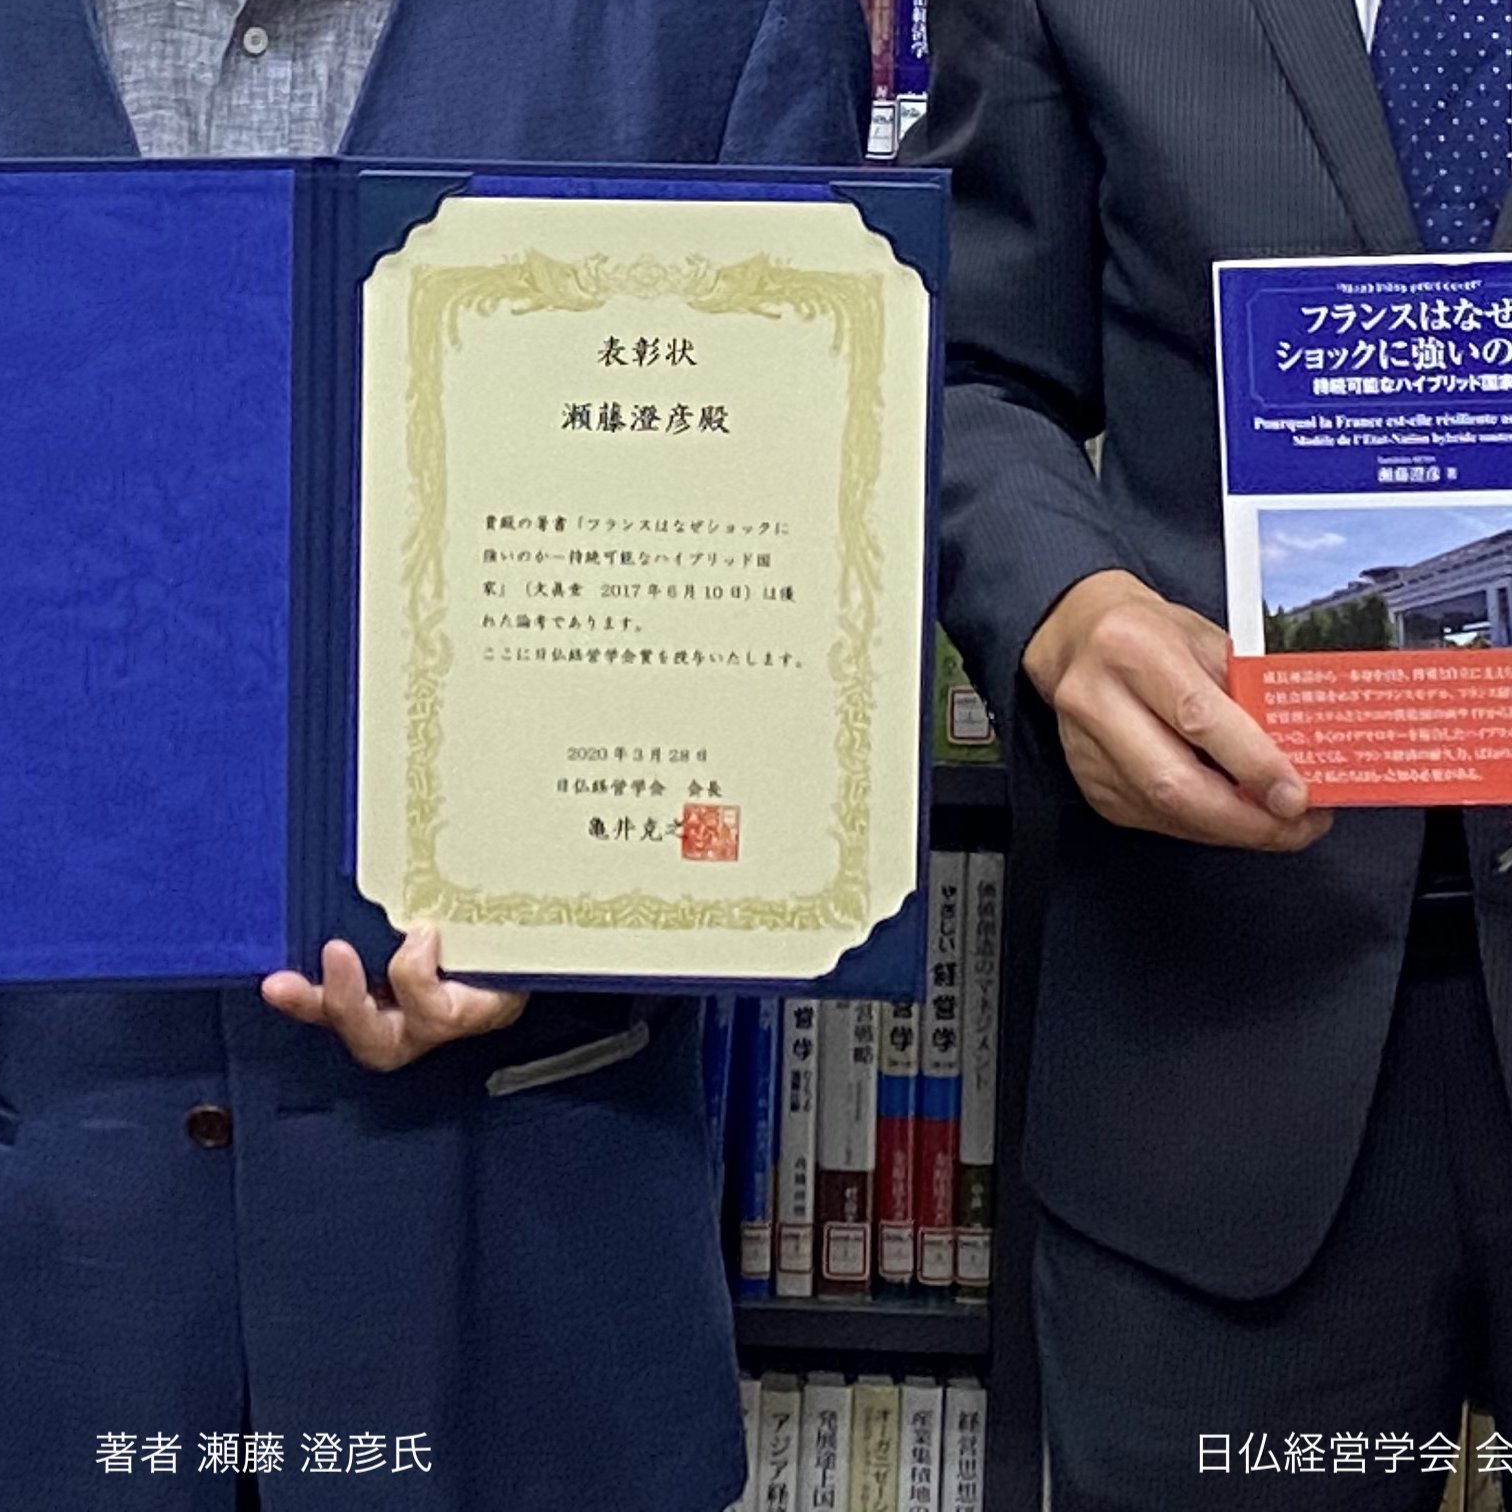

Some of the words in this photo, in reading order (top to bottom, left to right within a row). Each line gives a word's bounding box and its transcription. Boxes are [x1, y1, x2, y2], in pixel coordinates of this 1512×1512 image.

[597, 336, 698, 368] 表彰状
[560, 403, 732, 435] 瀬藤澄彦殿
[1336, 414, 1383, 429] France
[932, 963, 957, 1053] 経営学
